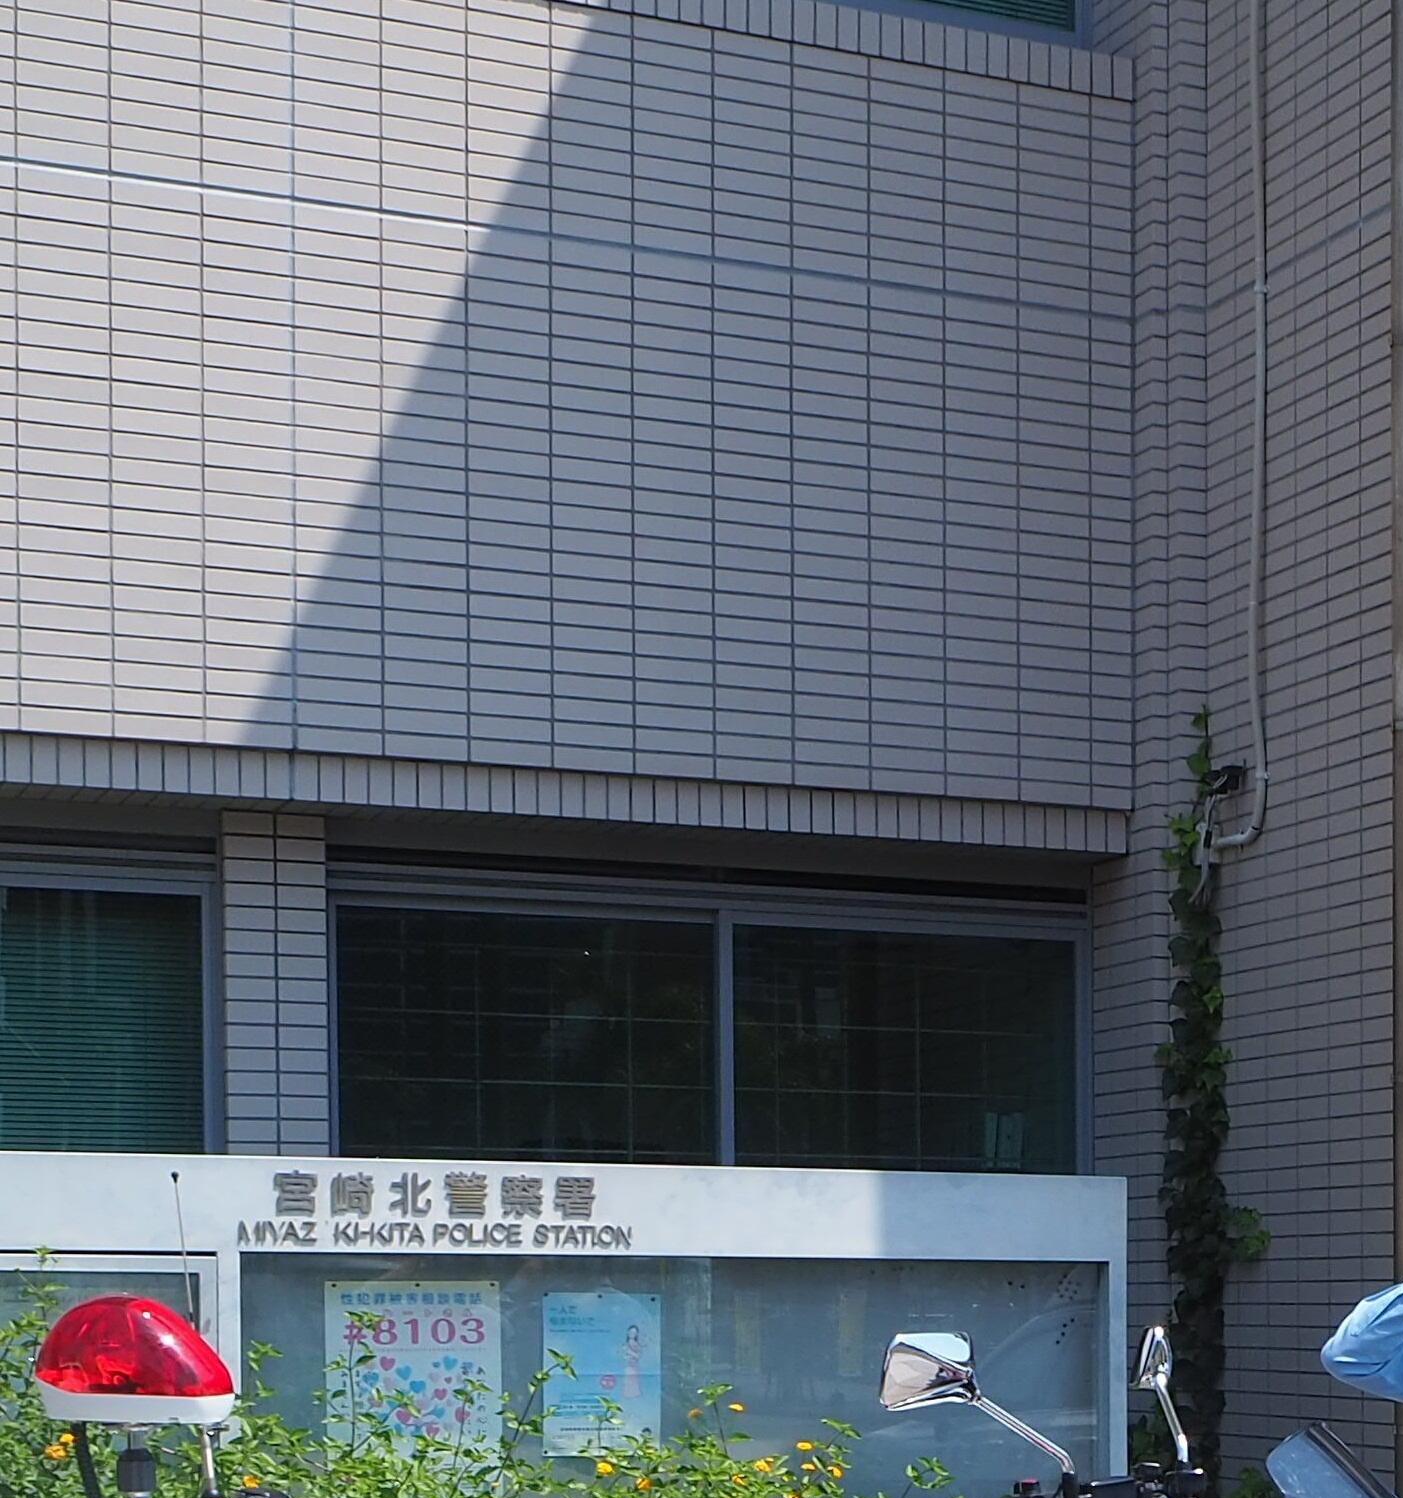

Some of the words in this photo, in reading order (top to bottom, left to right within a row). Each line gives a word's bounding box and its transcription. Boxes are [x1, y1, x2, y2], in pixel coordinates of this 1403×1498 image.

[273, 1170, 597, 1220] 宮崎北警察署
[432, 1222, 523, 1248] POLICE
[531, 1223, 632, 1250] STATION
[343, 1318, 485, 1345] #8103
